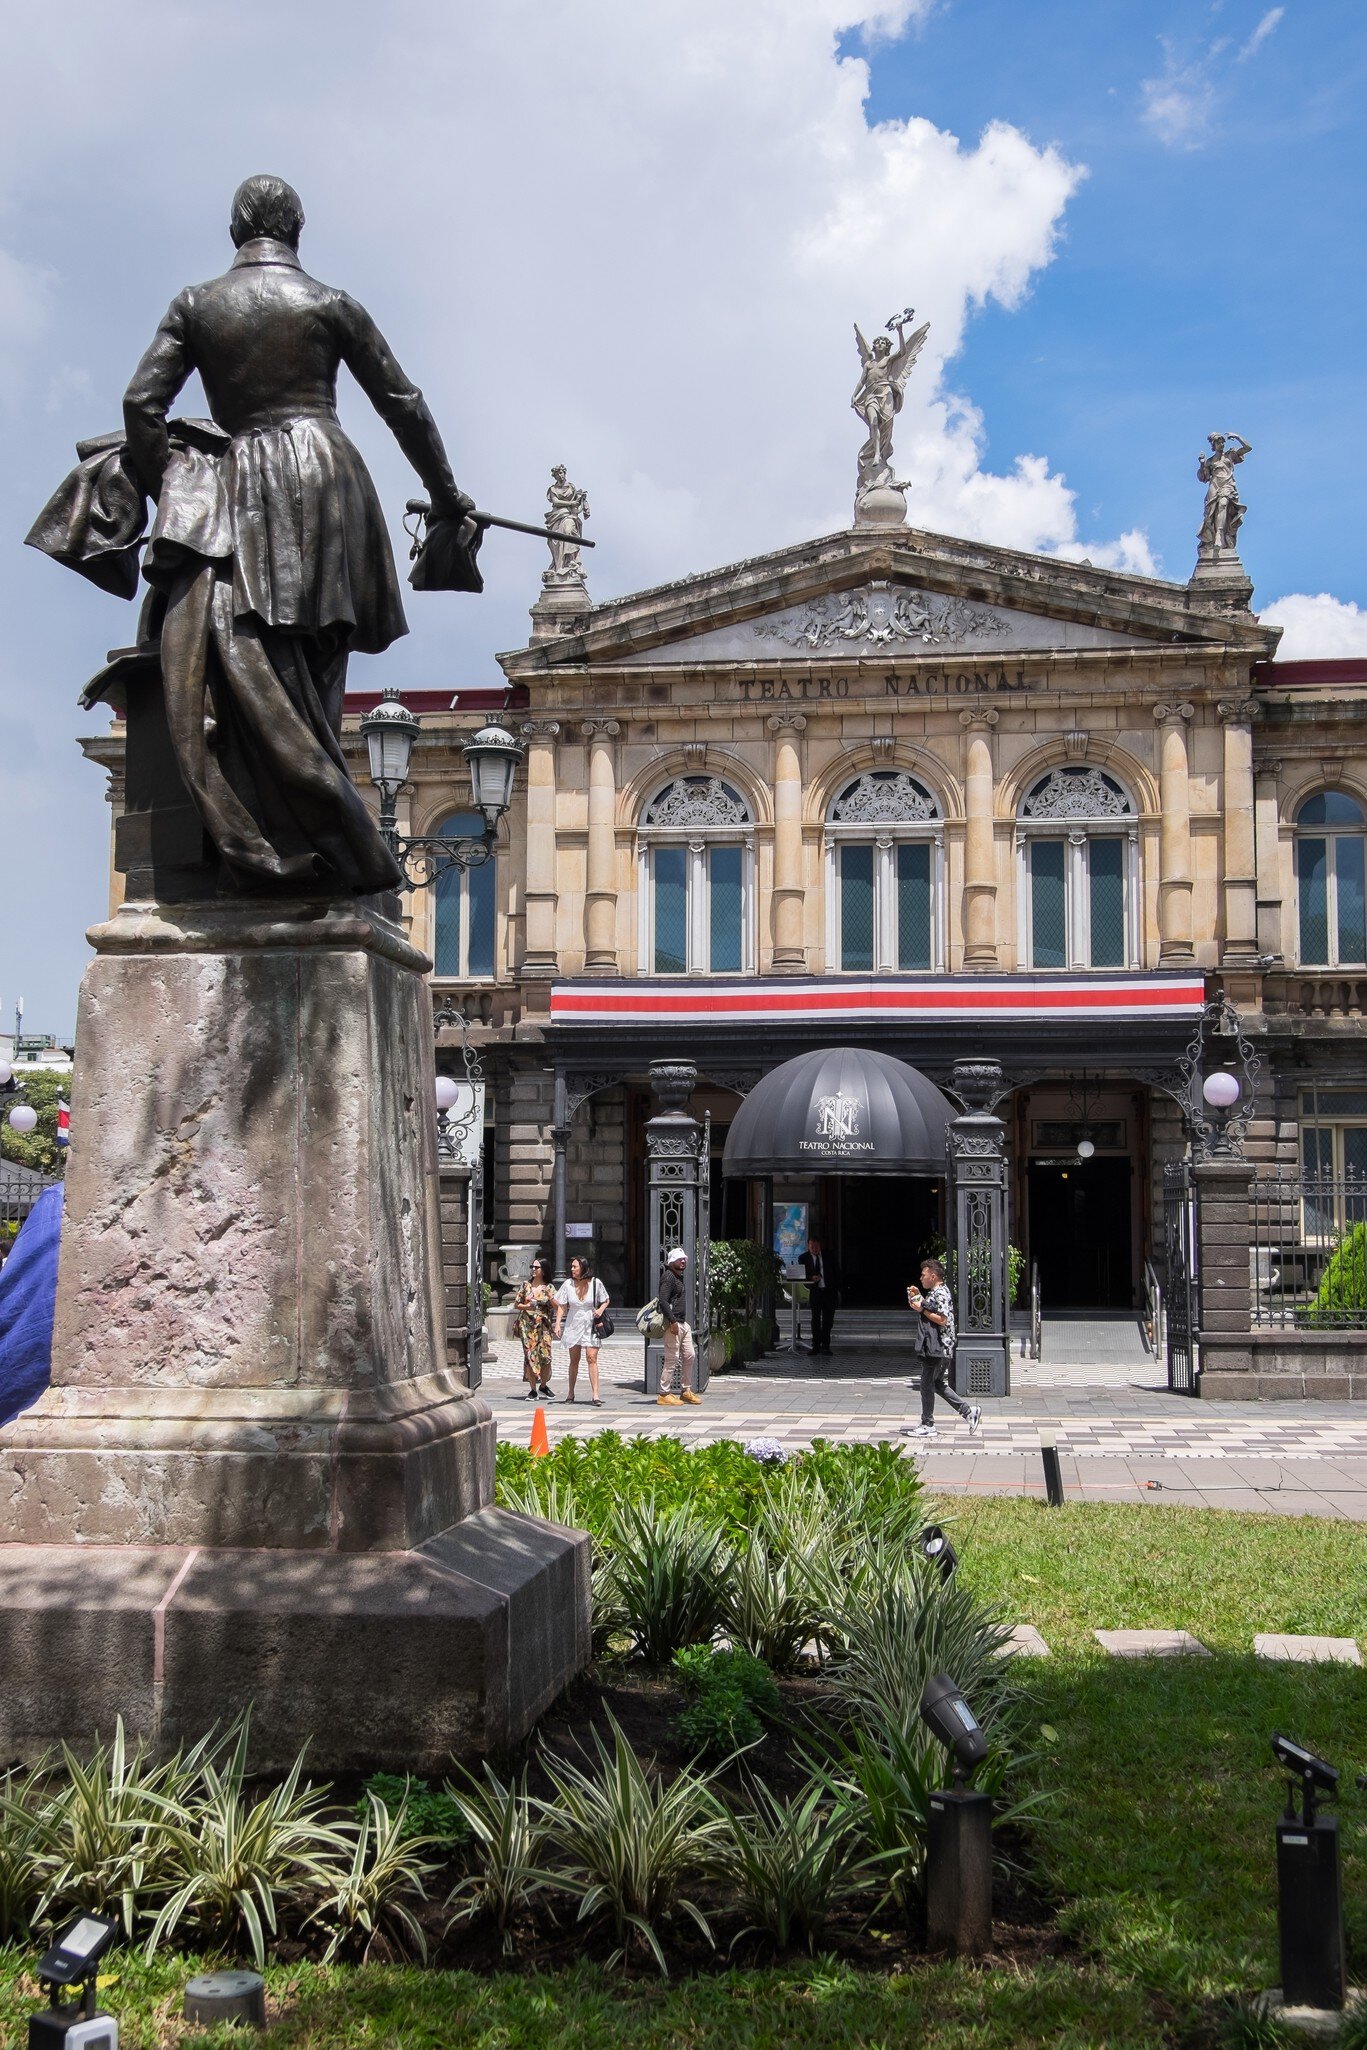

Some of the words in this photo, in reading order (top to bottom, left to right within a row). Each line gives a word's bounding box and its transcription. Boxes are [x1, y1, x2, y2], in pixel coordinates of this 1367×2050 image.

[739, 677, 850, 699] TEATRO
[884, 671, 1032, 695] NACIONAL
[799, 1141, 830, 1150] TEATRO
[832, 1141, 875, 1150] NACIONAL
